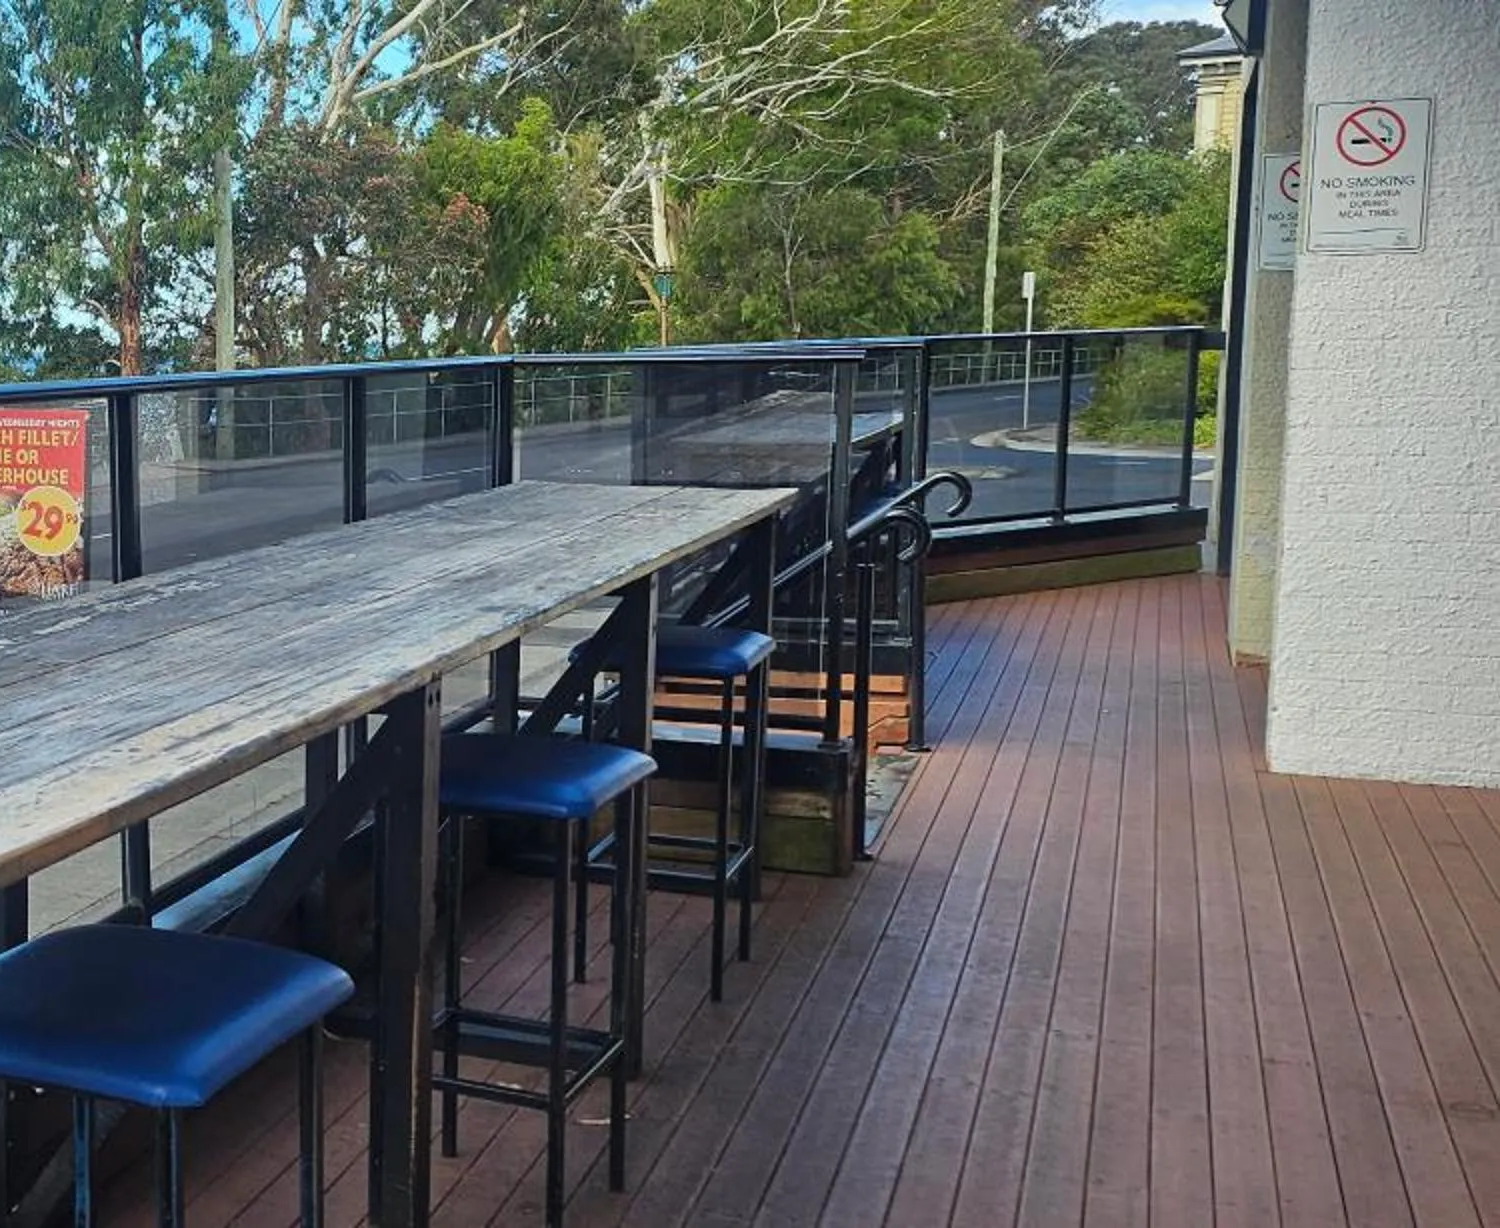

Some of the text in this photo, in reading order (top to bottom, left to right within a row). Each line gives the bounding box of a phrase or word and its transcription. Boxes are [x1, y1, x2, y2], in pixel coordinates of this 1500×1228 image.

[1320, 175, 1416, 189] NO SMOKING
[1374, 189, 1401, 197] AREA
[1369, 208, 1399, 217] TIMES
[19, 429, 80, 448] FILLET/
[15, 448, 39, 466] OR
